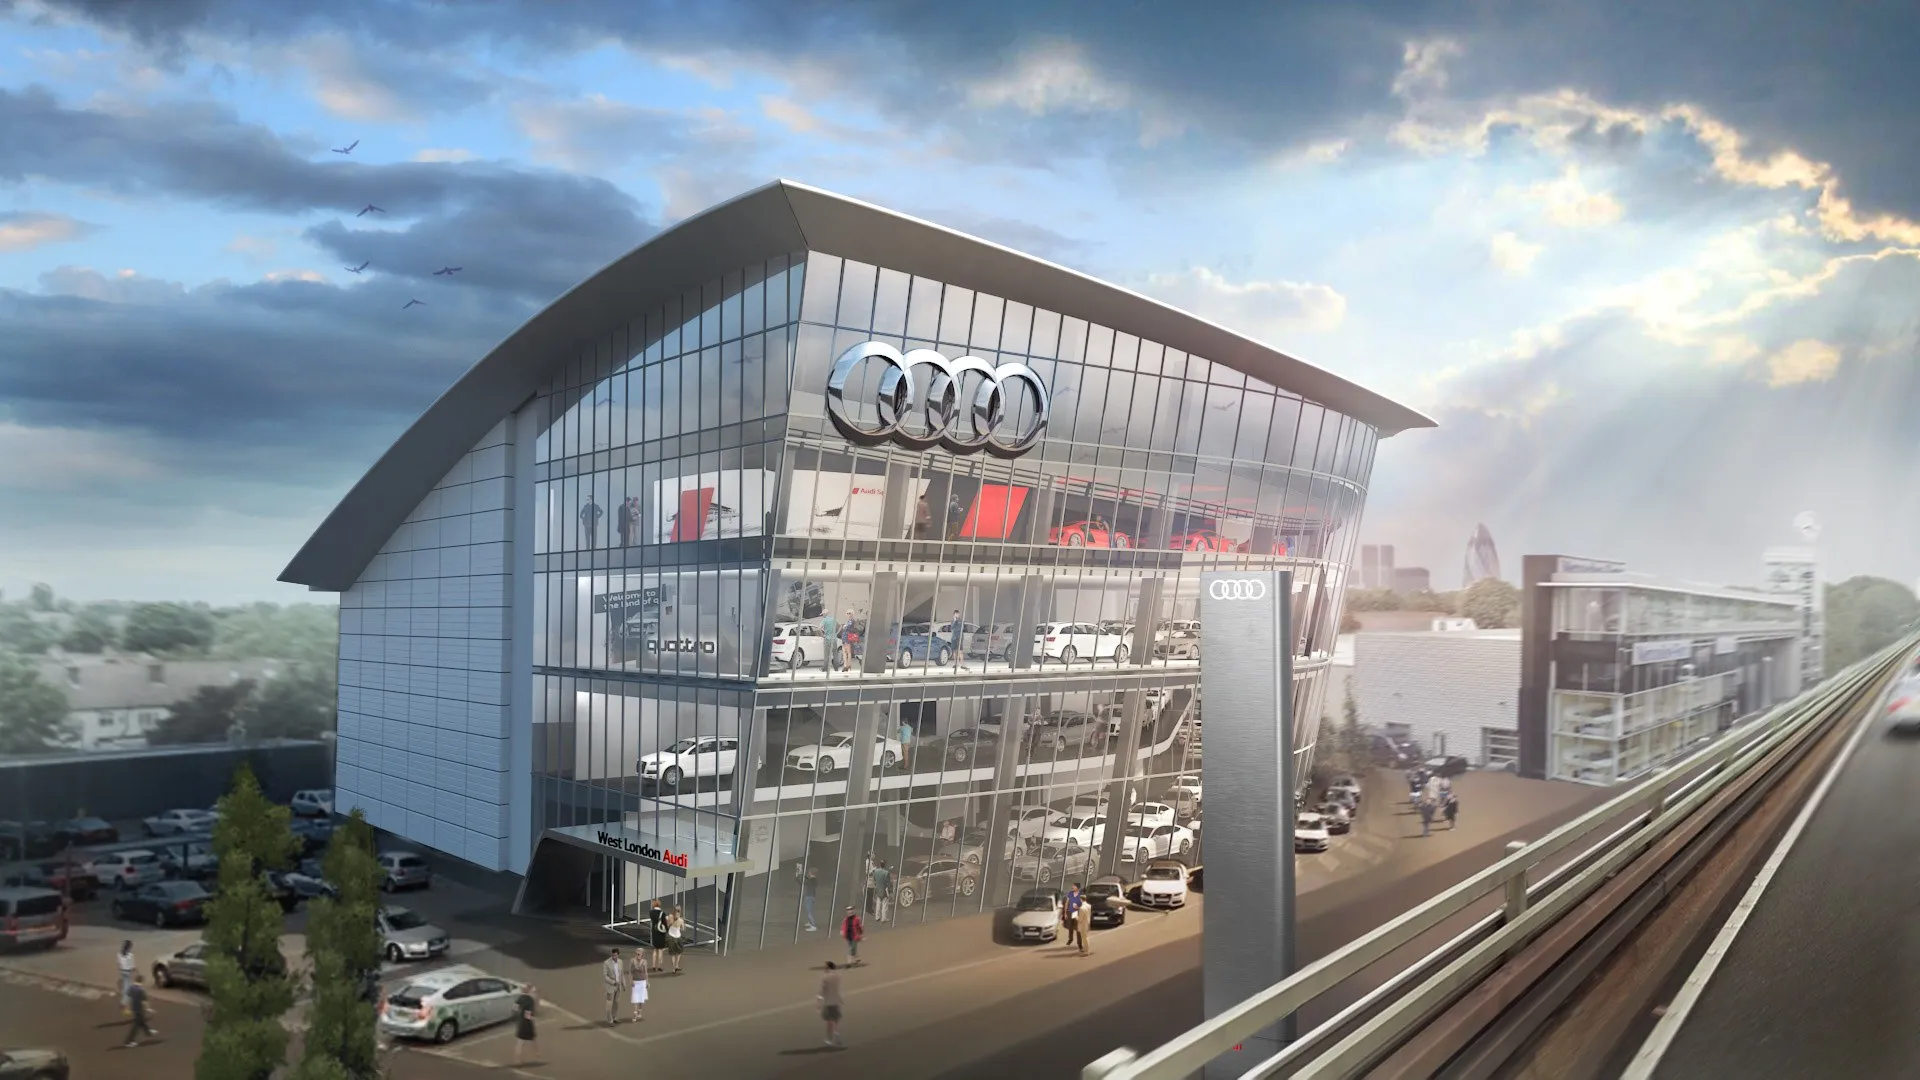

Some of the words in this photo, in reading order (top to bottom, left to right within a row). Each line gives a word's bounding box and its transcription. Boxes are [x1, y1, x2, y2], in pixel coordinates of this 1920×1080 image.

[603, 592, 642, 602] Welcom
[604, 602, 619, 610] the
[621, 600, 640, 608] land
[643, 597, 653, 605] of
[647, 638, 715, 654] quattro
[597, 830, 622, 849] West
[624, 838, 660, 860] London
[663, 849, 688, 867] Audi
